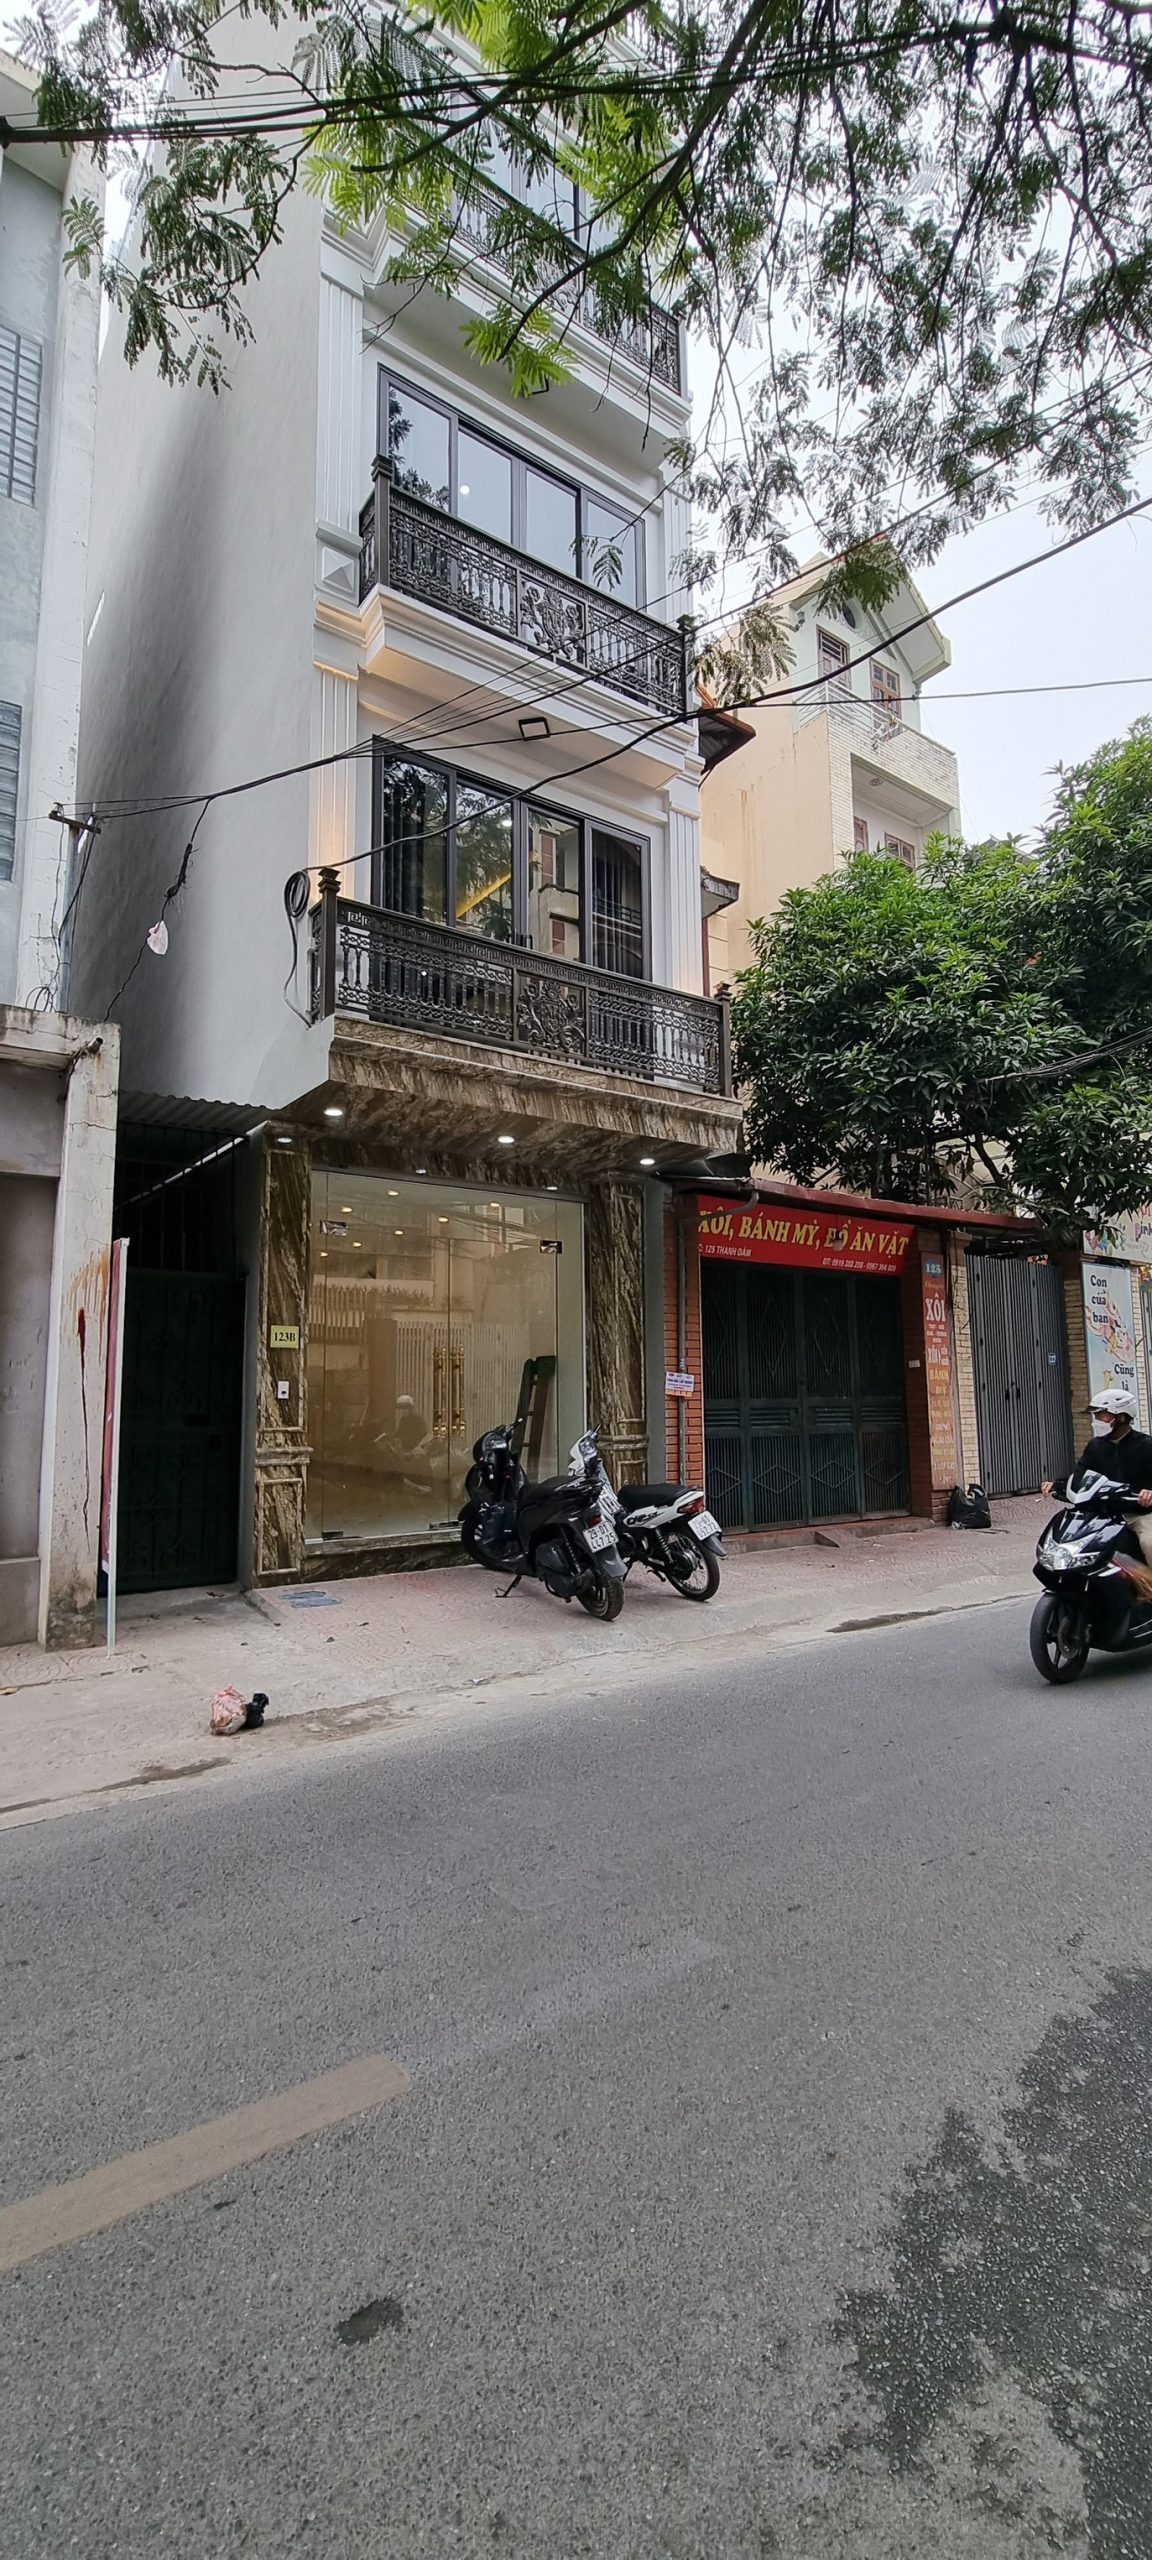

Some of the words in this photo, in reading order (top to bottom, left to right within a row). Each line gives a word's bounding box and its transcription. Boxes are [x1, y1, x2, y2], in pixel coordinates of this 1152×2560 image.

[739, 1212, 791, 1242] BÁNH
[791, 1219, 820, 1251] MỲ,
[849, 1226, 876, 1252] ĂN
[878, 1230, 909, 1259] VẶT
[704, 1244, 716, 1254] 125
[716, 1245, 737, 1256] THANH
[926, 1263, 942, 1274] 125
[1090, 1274, 1107, 1288] Con
[1091, 1289, 1107, 1305] của
[925, 1291, 946, 1322] XÔI
[274, 1331, 296, 1342] 123B
[1114, 1363, 1134, 1378] Cũng
[1121, 1379, 1129, 1391] là
